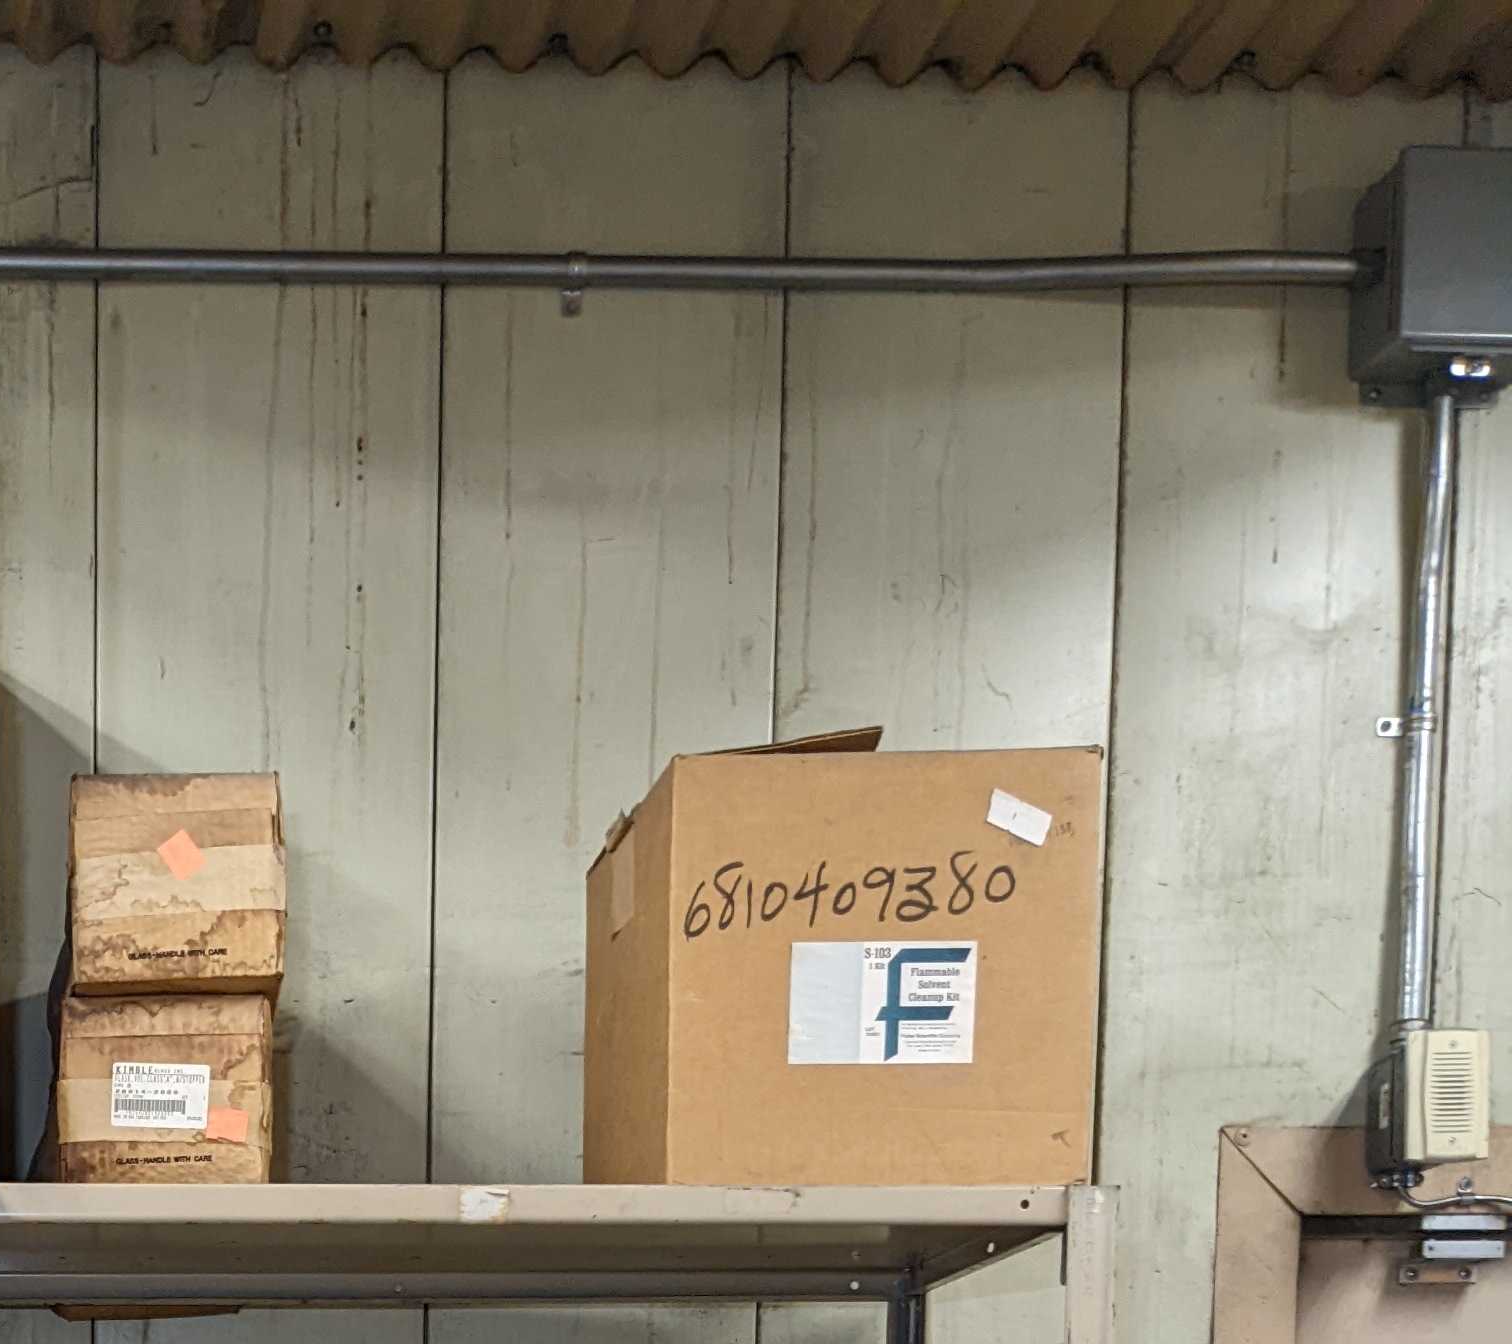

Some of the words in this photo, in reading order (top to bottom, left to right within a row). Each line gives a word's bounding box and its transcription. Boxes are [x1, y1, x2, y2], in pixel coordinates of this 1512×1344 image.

[683, 851, 1016, 940] 6810409380
[910, 967, 961, 977] Flammable
[918, 980, 951, 989] Solvent
